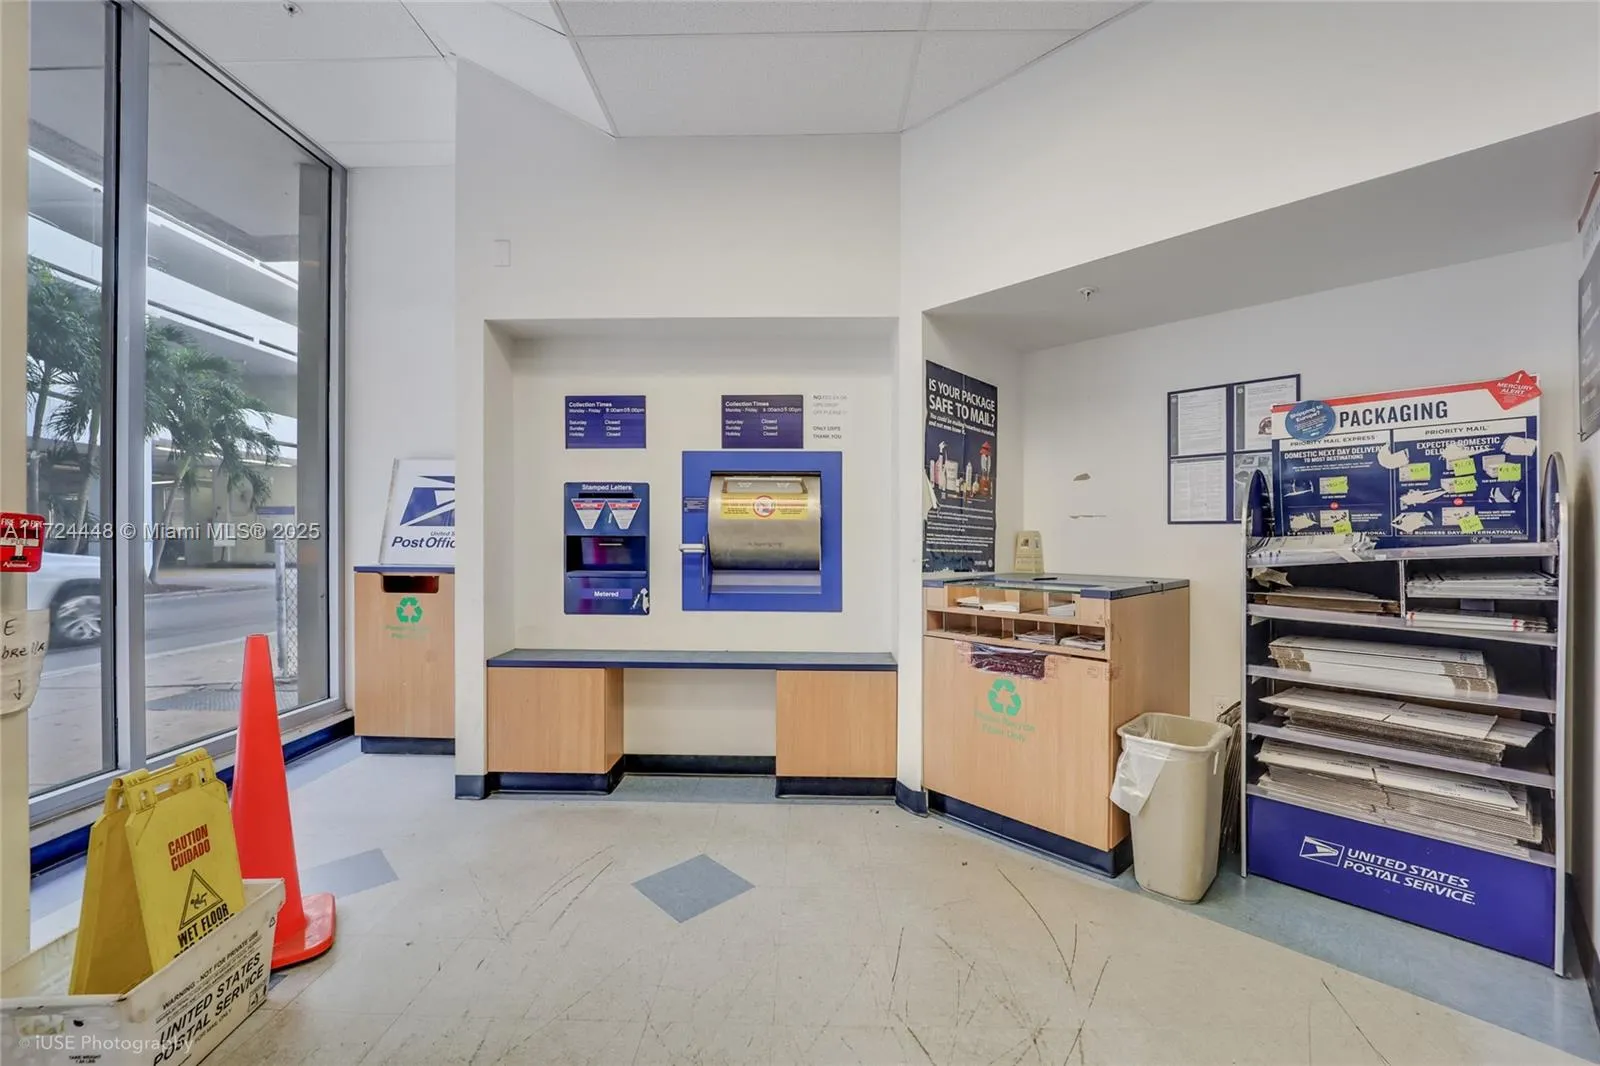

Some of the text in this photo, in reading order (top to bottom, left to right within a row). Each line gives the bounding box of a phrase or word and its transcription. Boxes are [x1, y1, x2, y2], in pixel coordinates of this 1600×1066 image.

[928, 378, 995, 412] IS YOUR PACKAGE
[1498, 382, 1533, 391] MERCURY
[929, 394, 995, 428] SAFE TO MAIL?
[1339, 400, 1448, 428] PACKAGING
[1284, 451, 1318, 460] DOMESTIC
[392, 536, 424, 548] Post
[4, 618, 18, 636] E
[168, 824, 208, 856] CAUTION
[171, 839, 210, 872] CUIDADO
[1343, 860, 1400, 884] POSTAL
[1348, 848, 1470, 888] UNITED STATES
[177, 922, 198, 948] WET
[201, 903, 229, 932] FLOOR
[163, 982, 196, 1010] WARNING
[200, 969, 213, 980] NOT
[214, 958, 226, 971] FOR
[227, 938, 248, 962] PRIVATE
[154, 1013, 211, 1066] POSTAL
[215, 964, 264, 1016] SERVICE
[161, 993, 212, 1045] UNITED
[216, 952, 260, 998] STATES
